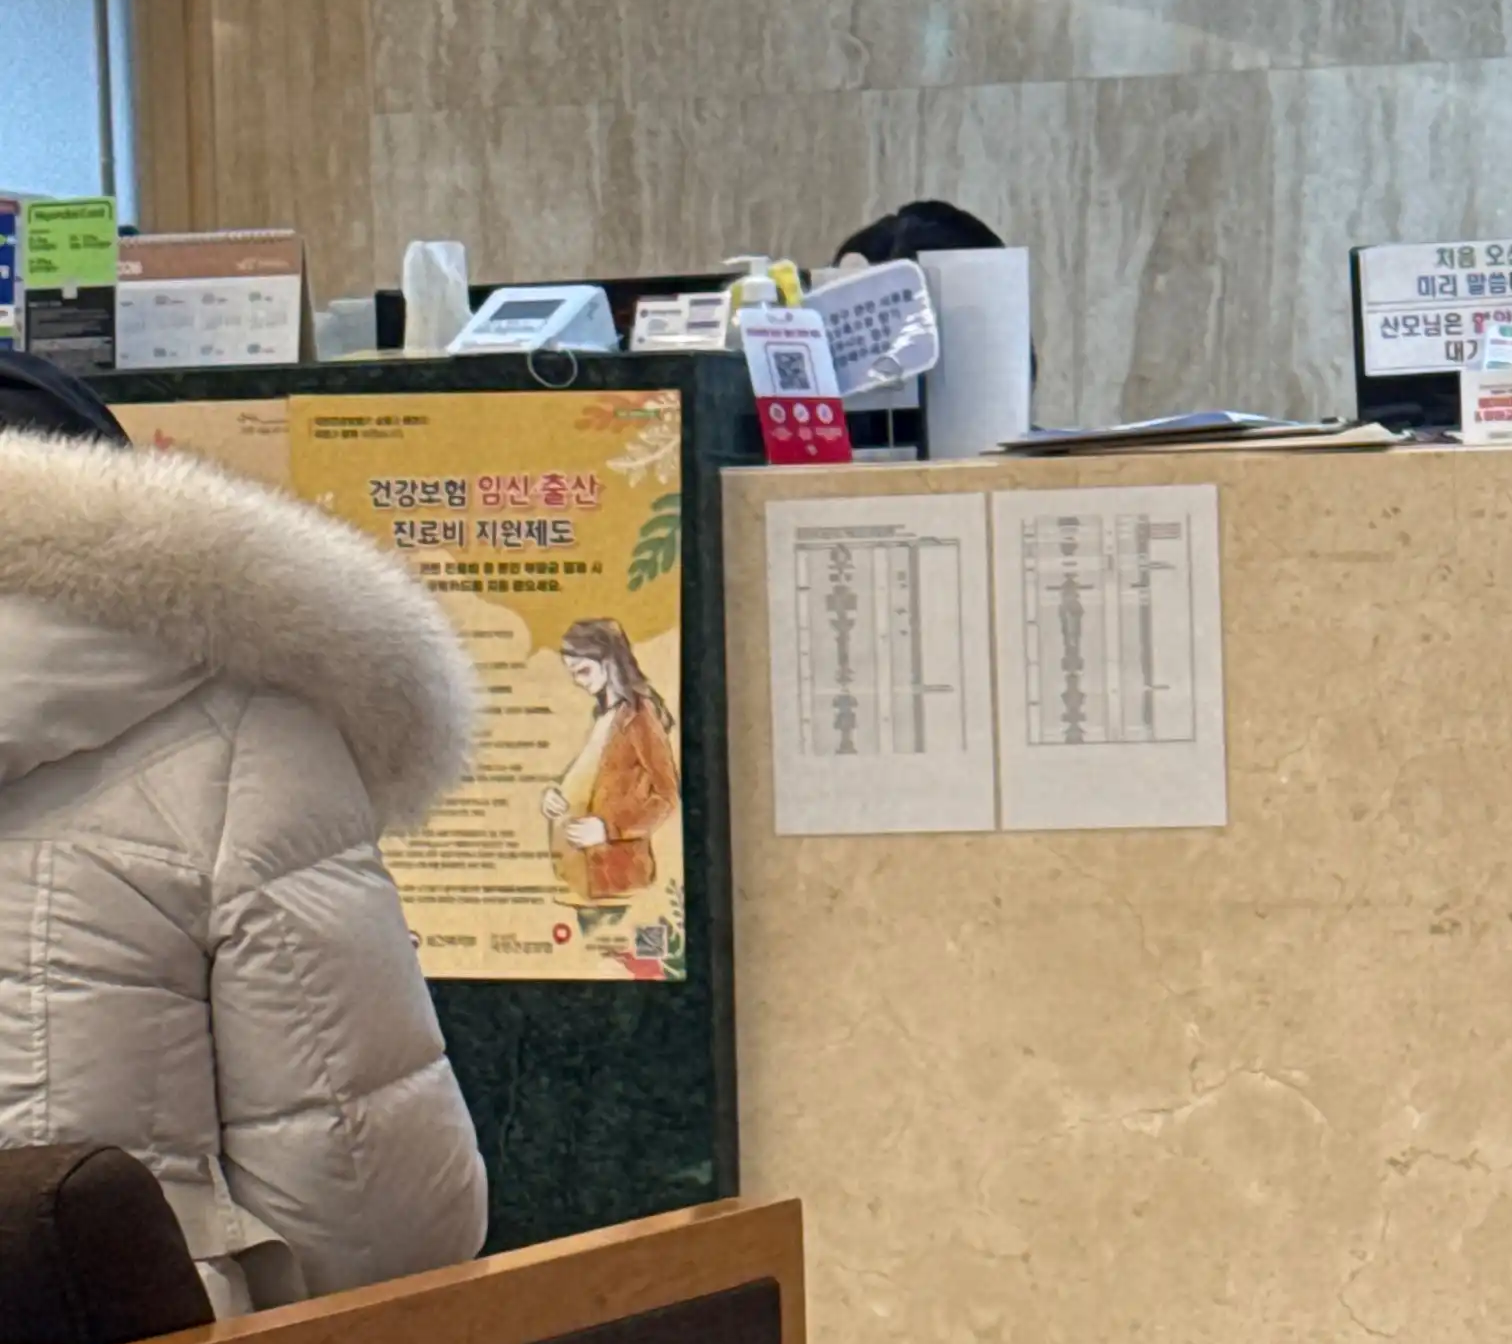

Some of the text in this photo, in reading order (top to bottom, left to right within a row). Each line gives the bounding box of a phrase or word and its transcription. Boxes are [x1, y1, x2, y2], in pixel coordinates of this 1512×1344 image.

[1436, 246, 1477, 269] 처음
[1417, 274, 1458, 299] 미리
[1380, 312, 1463, 339] 산모님은
[369, 480, 467, 508] 건강보험
[394, 520, 575, 548] 진료비 지원제도
